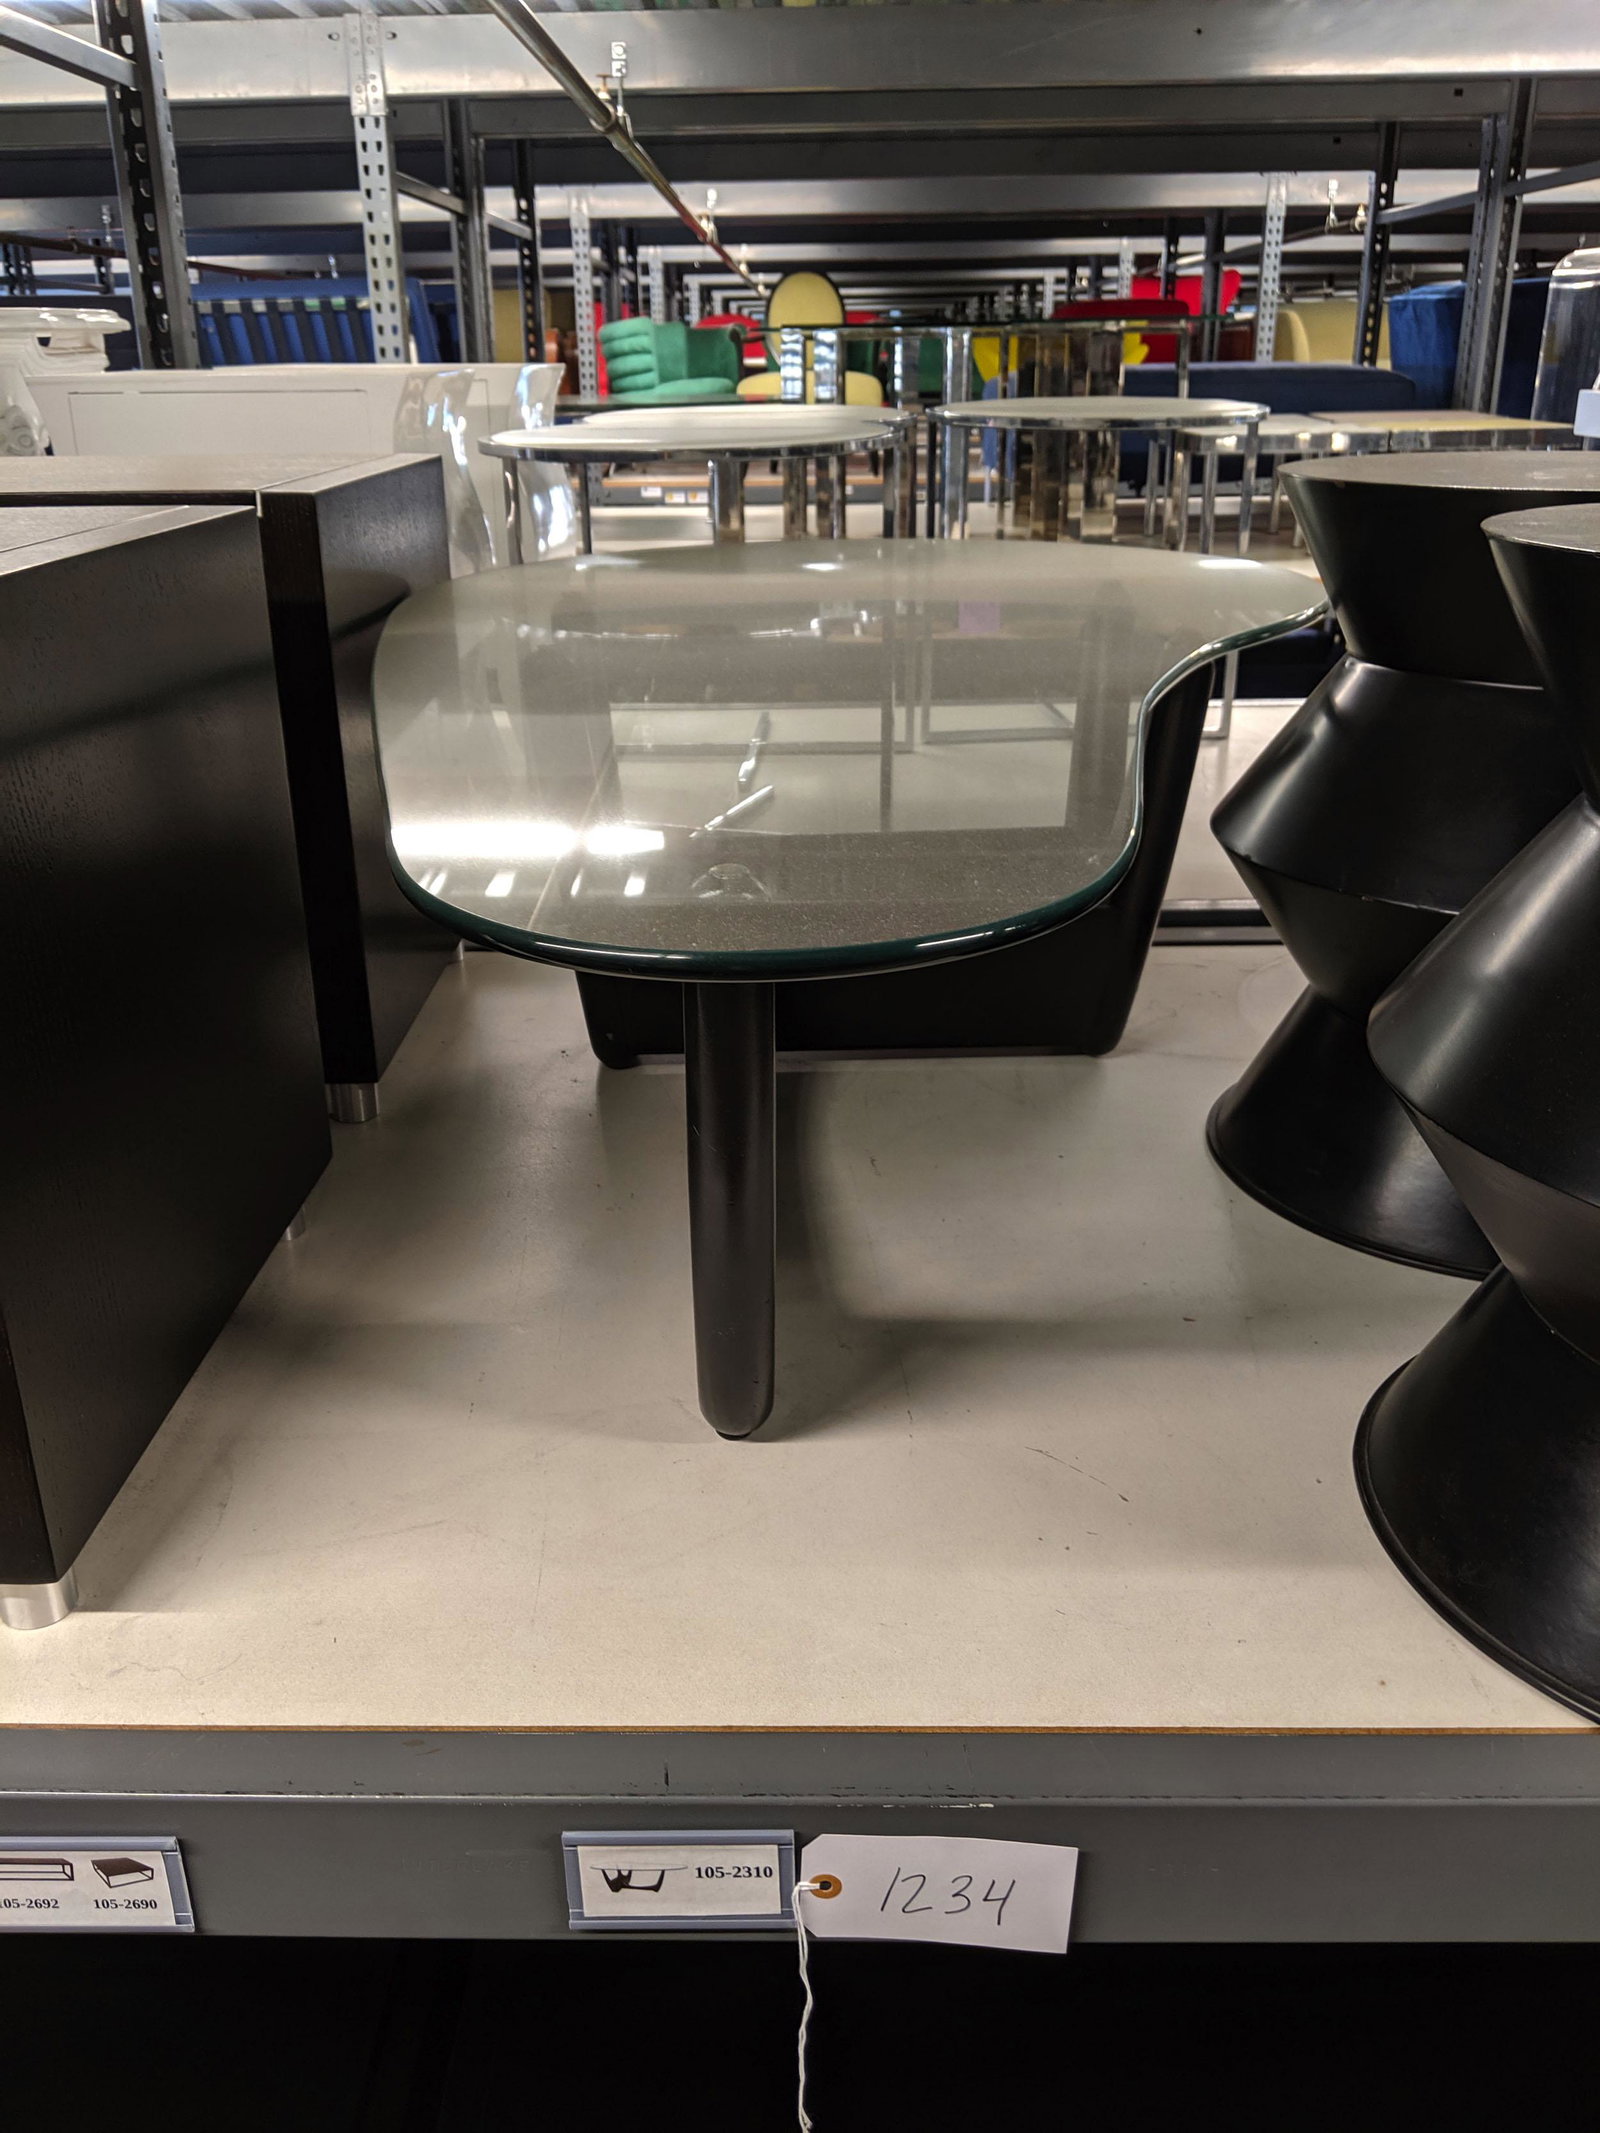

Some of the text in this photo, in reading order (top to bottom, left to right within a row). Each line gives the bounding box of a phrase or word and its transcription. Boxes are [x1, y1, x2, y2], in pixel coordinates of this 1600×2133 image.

[694, 1865, 774, 1879] 105-2310
[880, 1867, 1016, 1926] 1234
[93, 1898, 158, 1910] 105-2690
